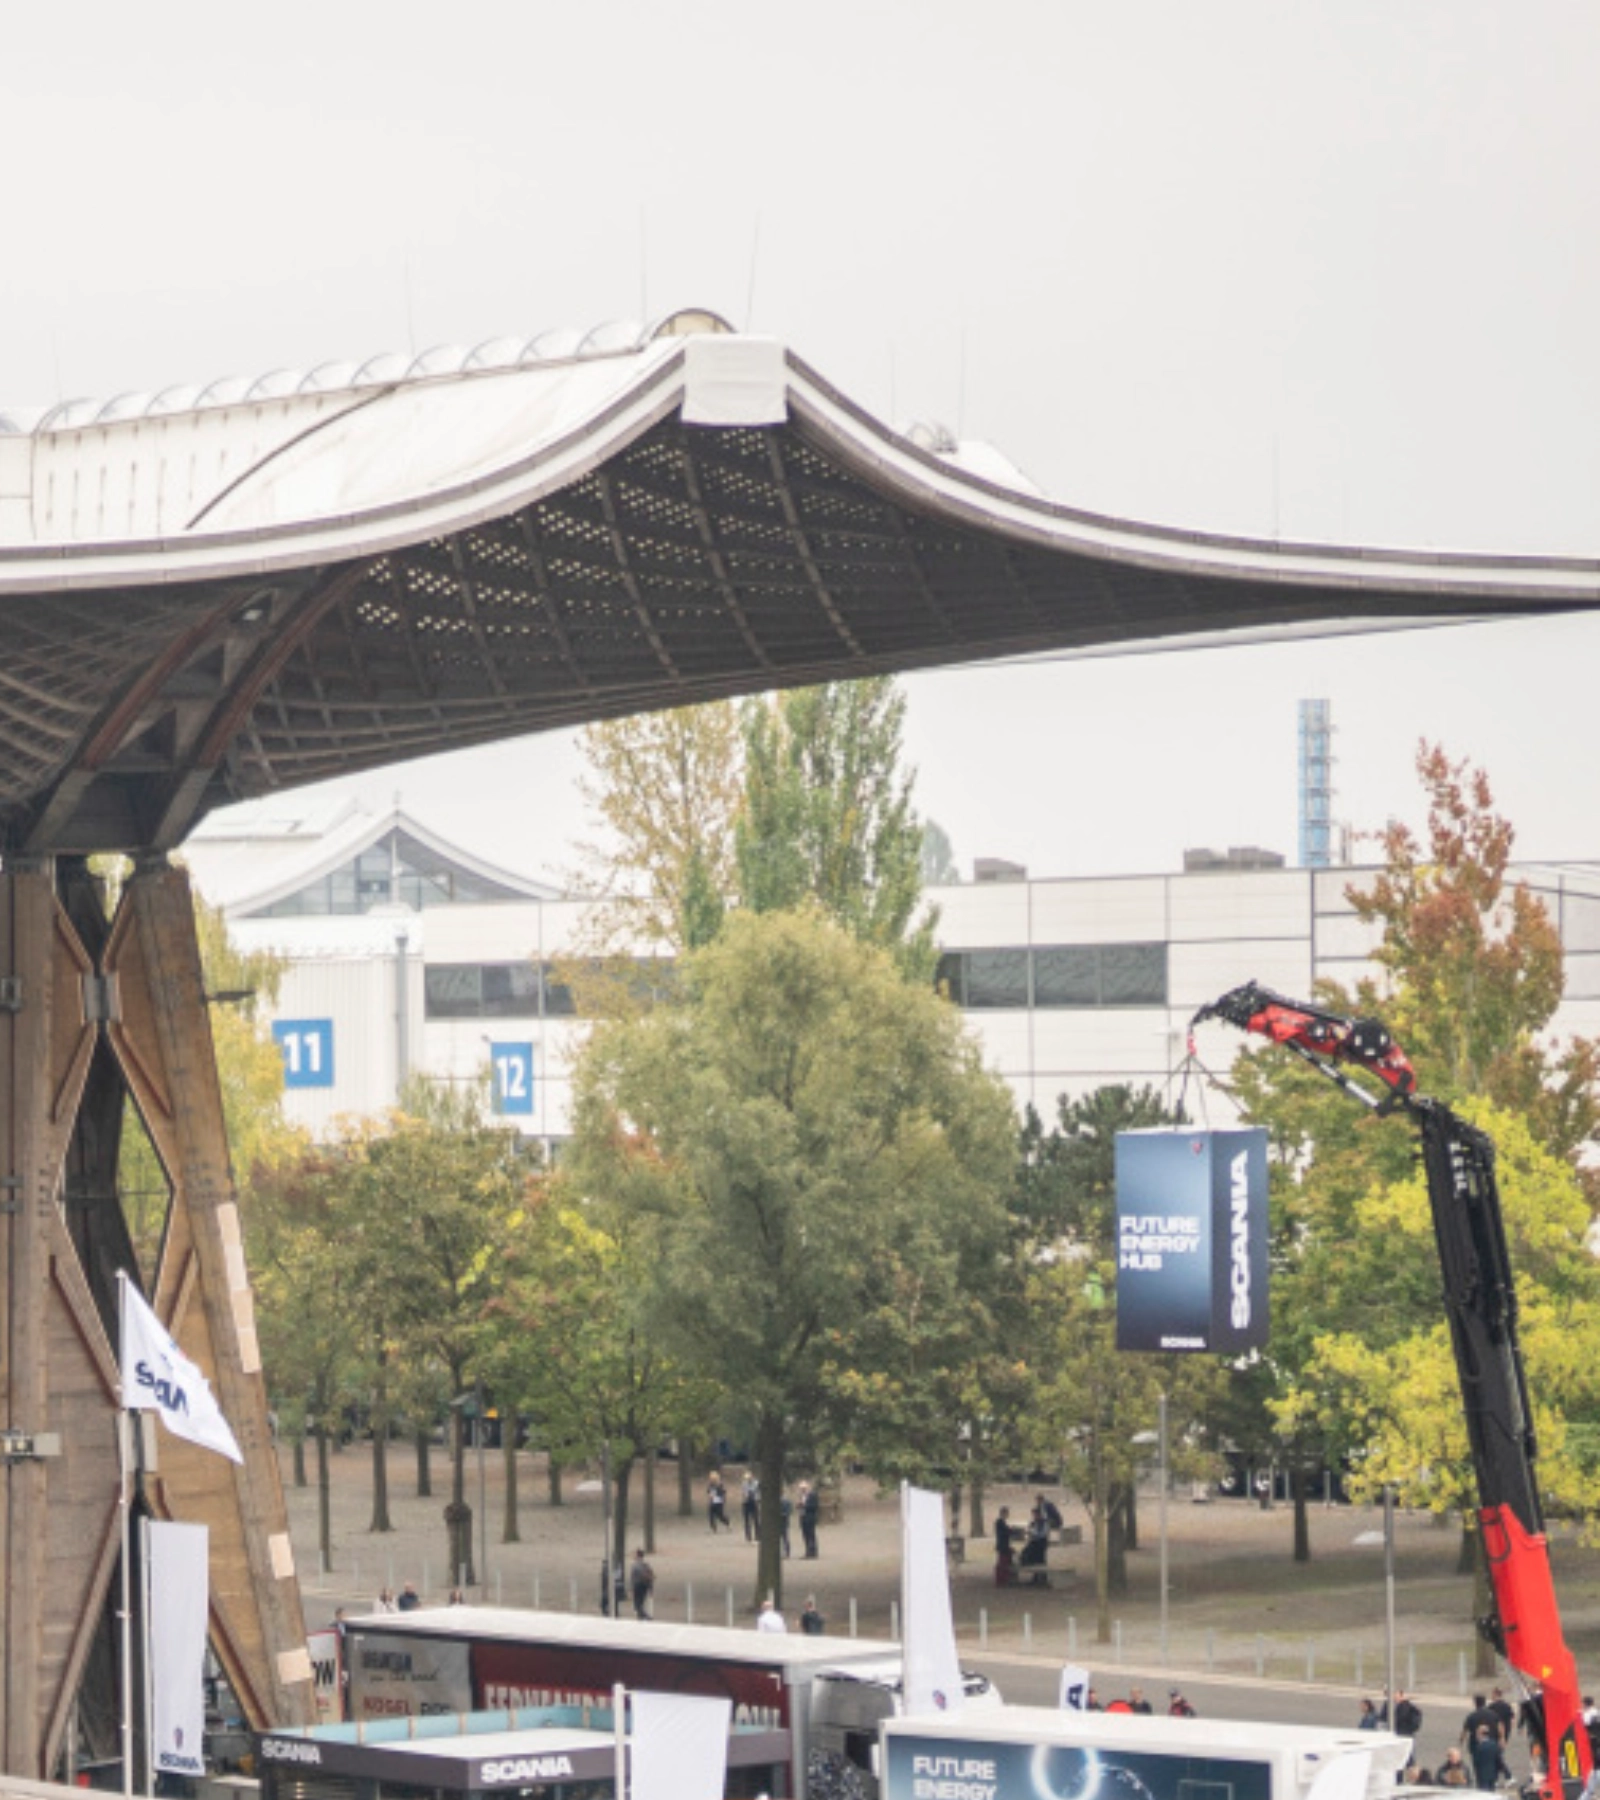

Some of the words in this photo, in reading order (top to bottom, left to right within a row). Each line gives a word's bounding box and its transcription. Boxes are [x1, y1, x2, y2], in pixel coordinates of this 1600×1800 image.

[284, 1031, 322, 1073] 11
[496, 1056, 527, 1098] 12
[1119, 1215, 1200, 1234] FUTURE
[1119, 1235, 1201, 1253] ENERGY
[1230, 1150, 1251, 1330] SCANIA
[1119, 1253, 1163, 1271] HUB
[262, 1739, 321, 1765] SCANIA
[481, 1756, 573, 1784] SCANIA
[913, 1756, 997, 1780] FUTURE
